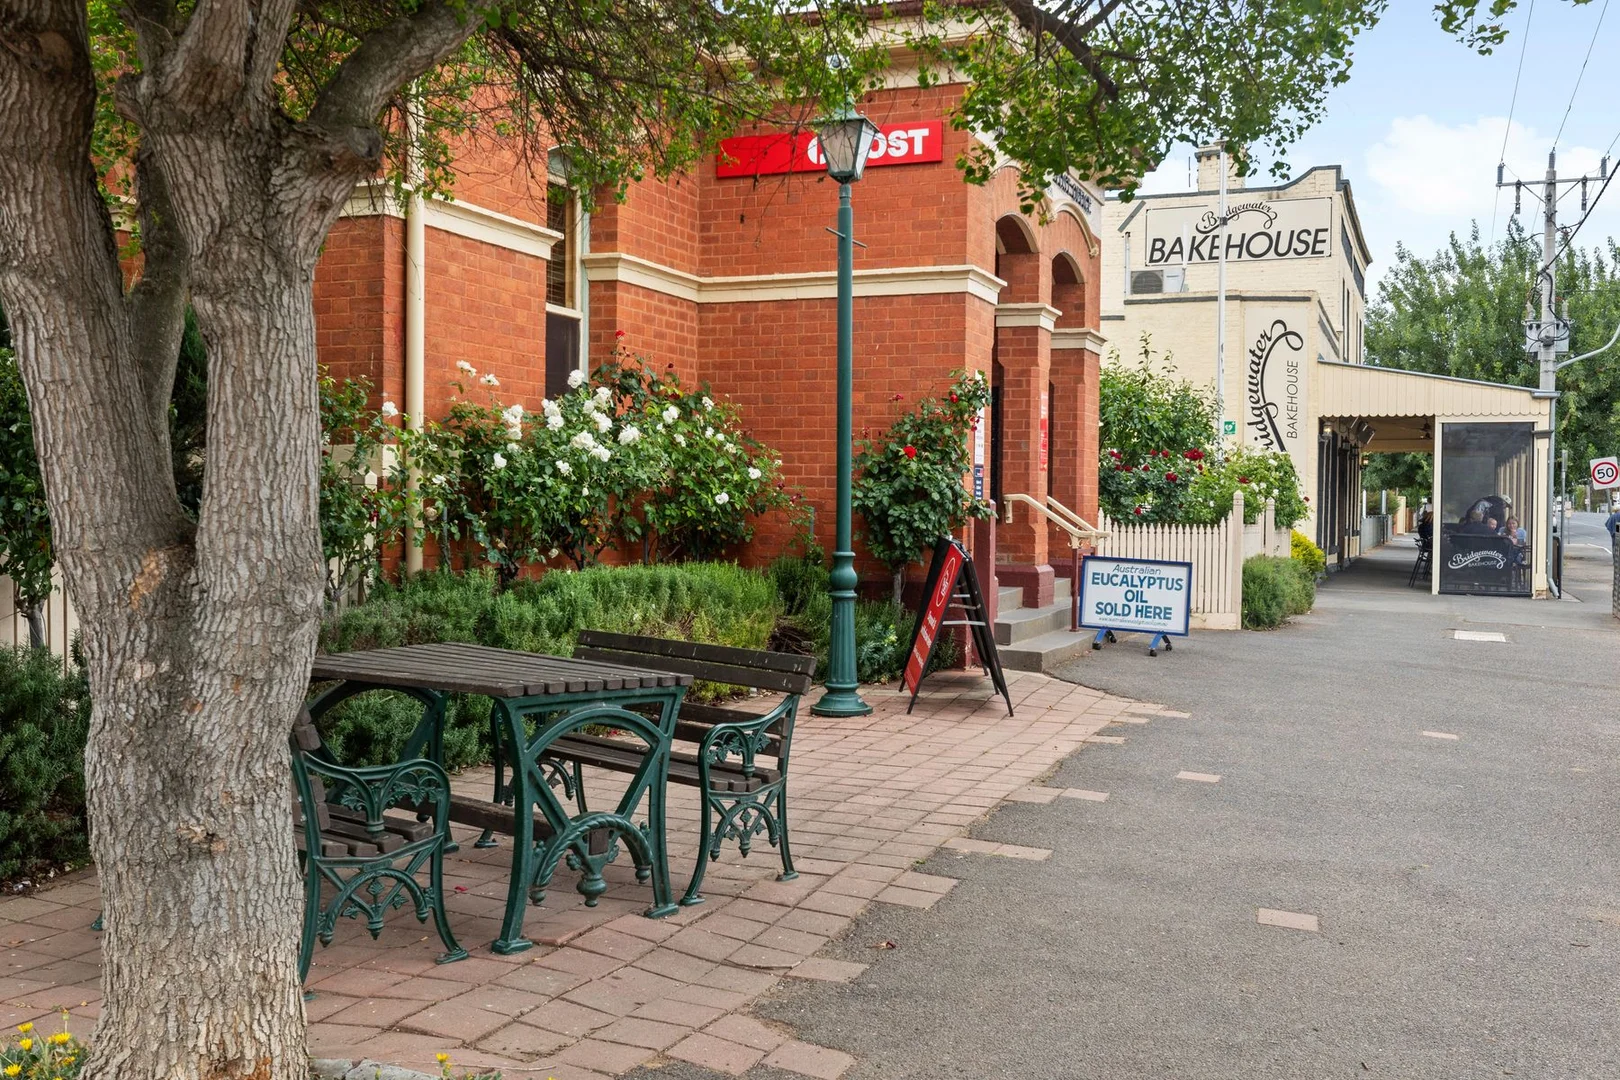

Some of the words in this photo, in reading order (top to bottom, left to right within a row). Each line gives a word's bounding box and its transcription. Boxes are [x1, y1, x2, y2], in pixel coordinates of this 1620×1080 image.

[867, 128, 930, 159] OST
[1196, 201, 1277, 234] Bdgewater
[1149, 228, 1329, 263] BAKEHOUSE
[1247, 319, 1287, 452] ridgewater
[1286, 360, 1299, 439] BAKEHOUSE
[1597, 467, 1614, 479] 50
[1449, 550, 1505, 569] Bridgewater
[1112, 564, 1161, 575] Australian
[1091, 572, 1183, 591] EUCALYPTUS
[1124, 589, 1148, 603] OIL
[1095, 601, 1131, 617] SOLD
[1135, 604, 1172, 620] HERE
